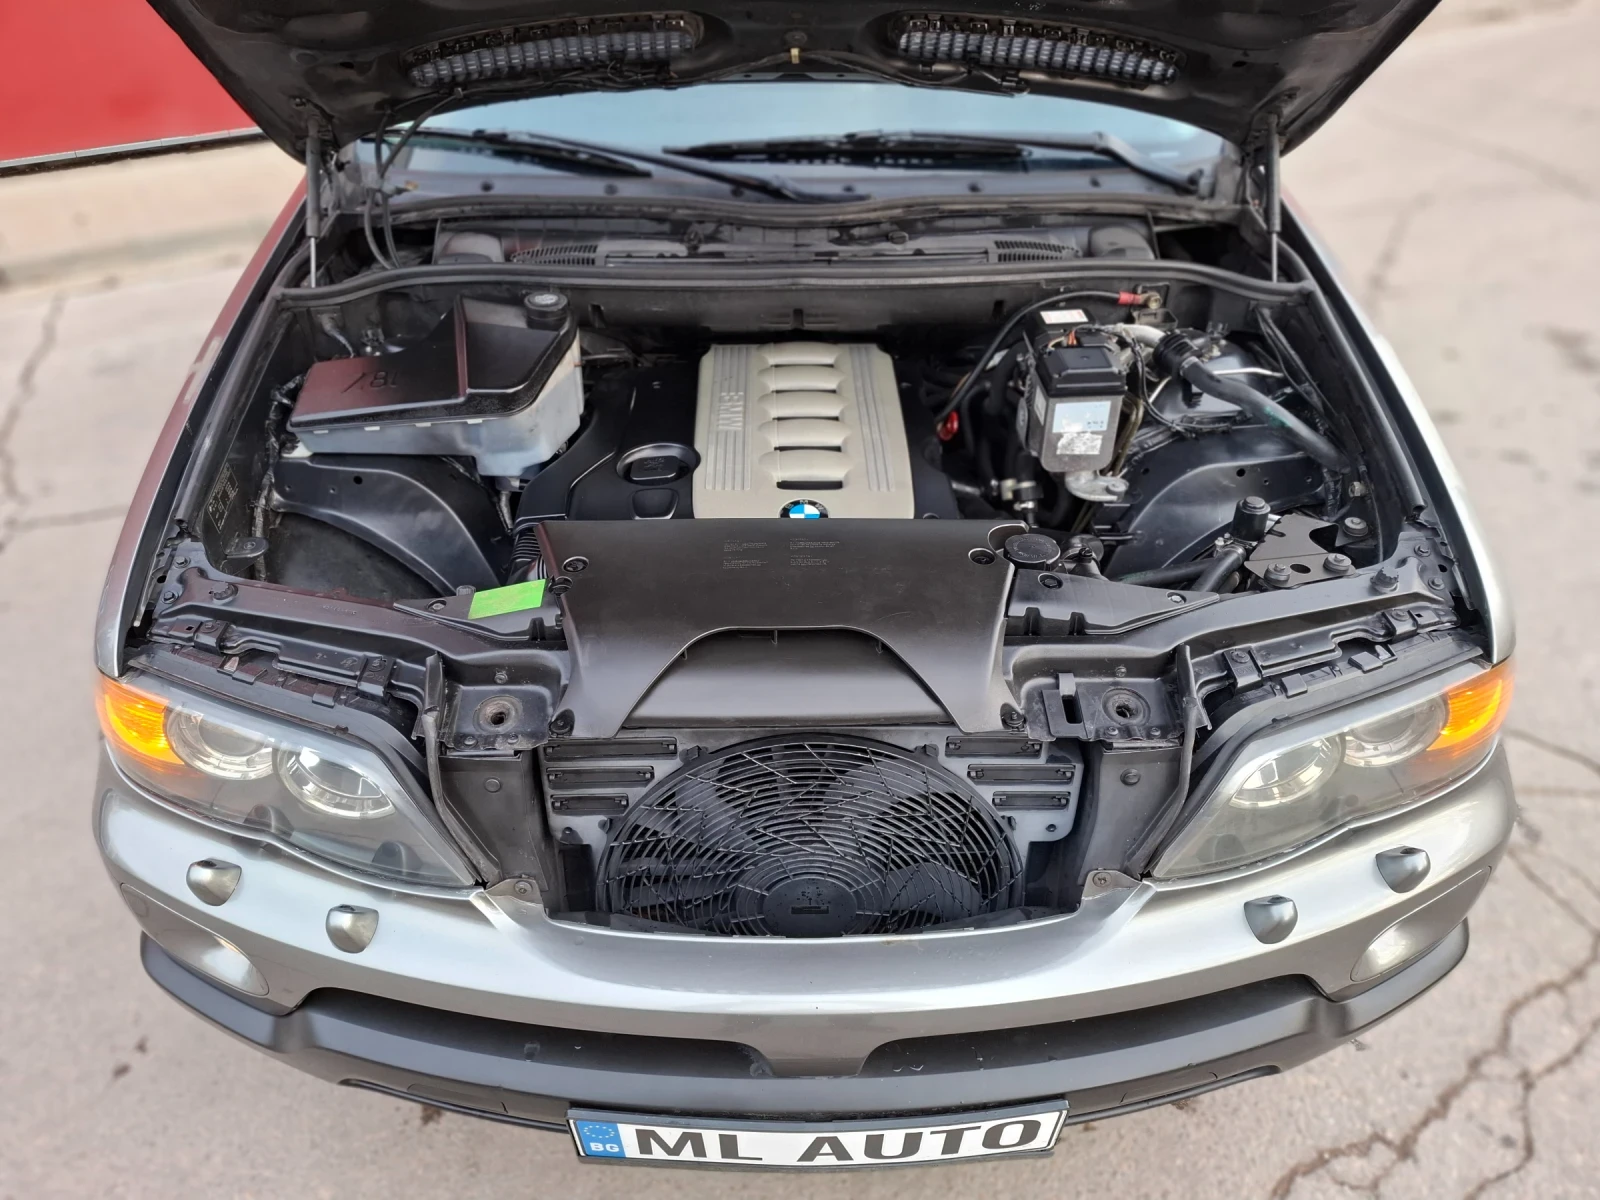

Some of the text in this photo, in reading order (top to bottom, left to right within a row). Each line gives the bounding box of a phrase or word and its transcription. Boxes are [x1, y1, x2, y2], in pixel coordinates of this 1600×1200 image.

[719, 391, 744, 430] BMW
[589, 1119, 1042, 1162] BG ML AUTO
